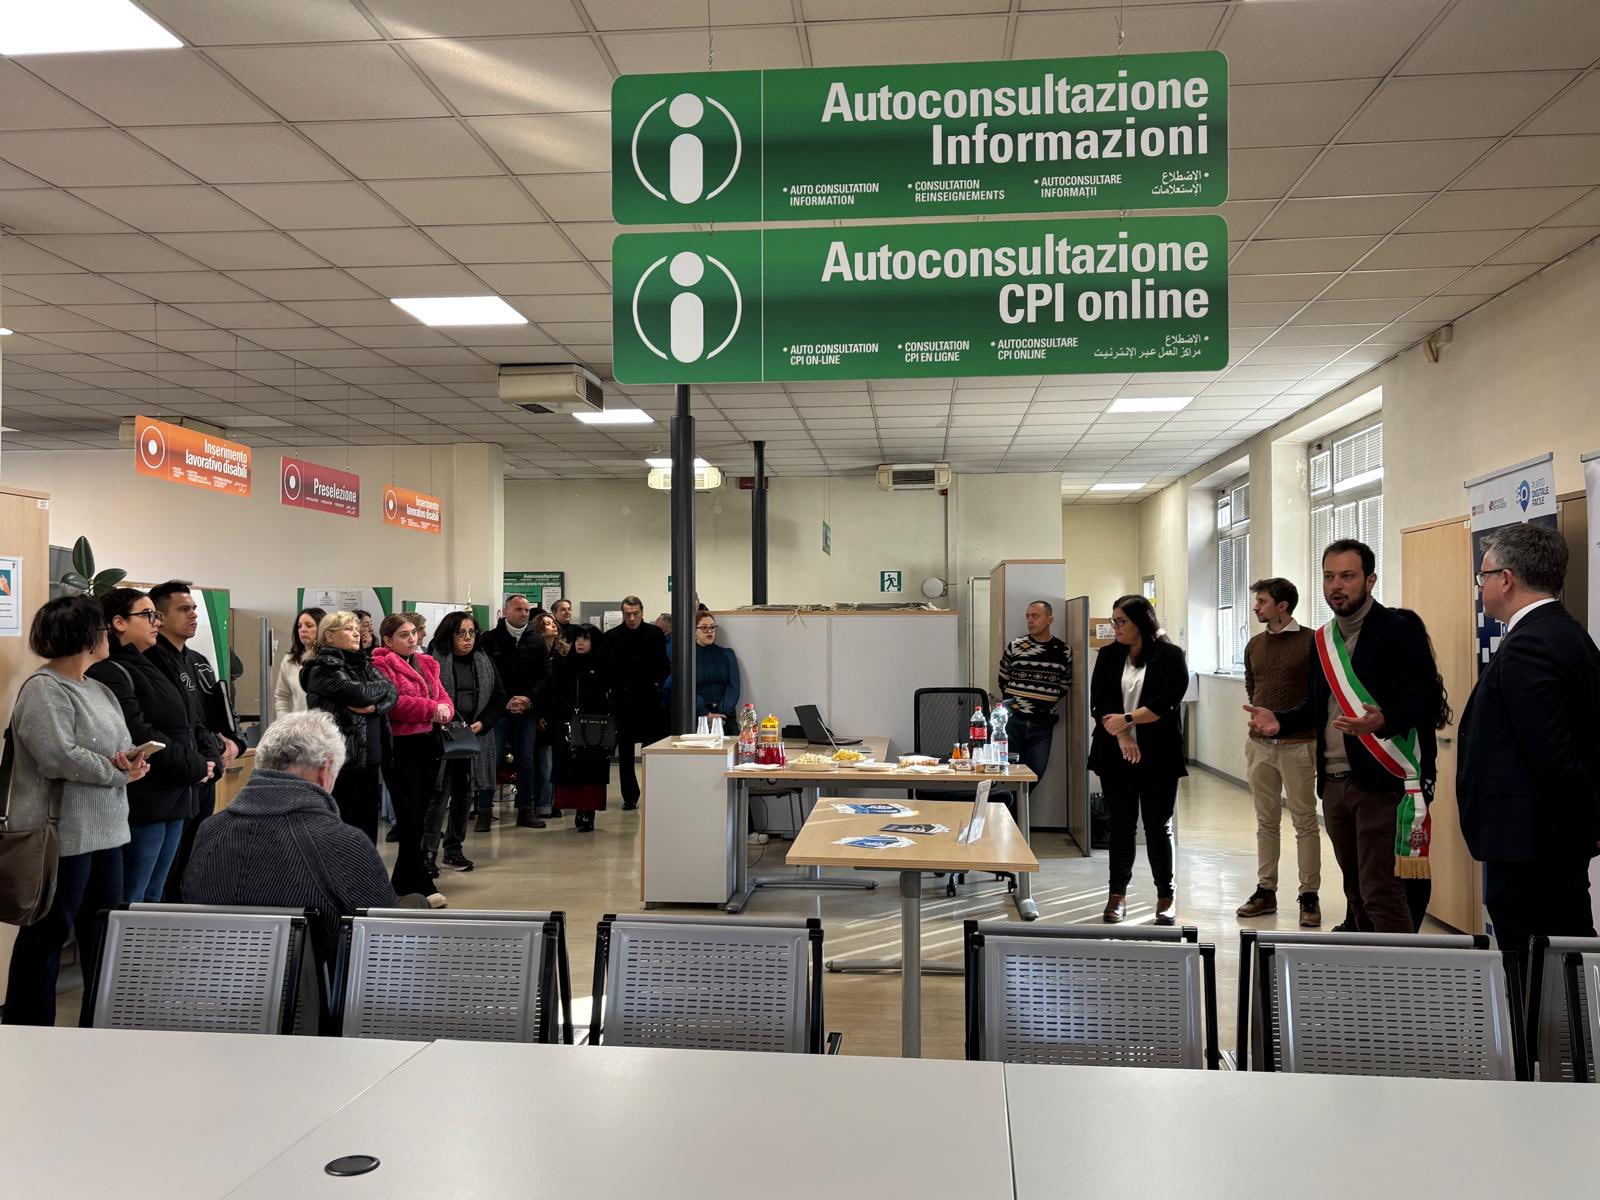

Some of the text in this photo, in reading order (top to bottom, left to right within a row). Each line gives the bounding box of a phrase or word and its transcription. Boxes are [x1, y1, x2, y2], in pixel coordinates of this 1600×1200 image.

[821, 69, 1209, 123] Autoconsultazione
[932, 113, 1208, 166] Informazioni
[914, 179, 980, 191] CONSULTATION
[1040, 174, 1122, 187] AUTOCONSULTARE
[789, 182, 880, 195] AUTO CONSULTATION
[789, 195, 855, 206] INFORMATION
[914, 189, 1005, 203] REINSEIGNEMENTS
[821, 231, 1209, 282] Autoconsultazione
[999, 278, 1209, 324] CPI online
[789, 343, 879, 355] AUTO CONSULTATION
[904, 340, 970, 352] CONSULTATION
[997, 337, 1079, 349] AUTOCONSULTARE
[789, 354, 841, 366] CPI ON-LINE
[904, 350, 960, 363] CPI EN LIGNE
[997, 348, 1047, 360] CPI ONLINE
[204, 438, 248, 464] Inserimento
[185, 448, 222, 473] lavorativo
[223, 459, 248, 479] disabili
[313, 477, 357, 503] Preselezione
